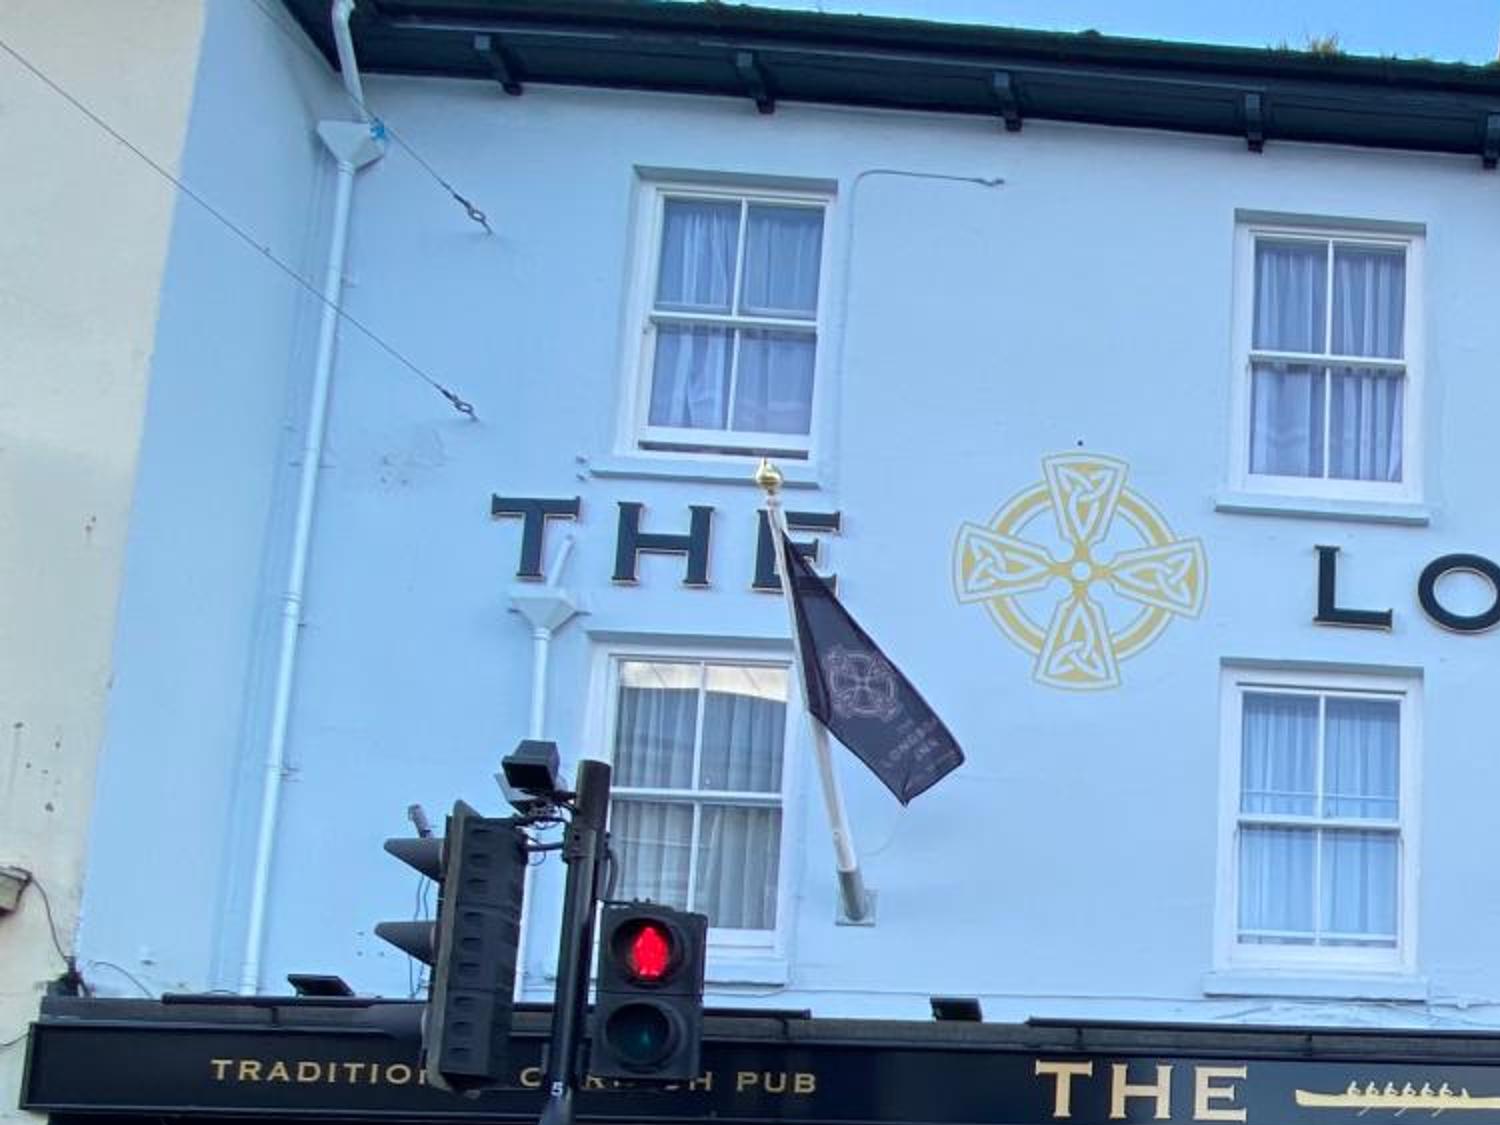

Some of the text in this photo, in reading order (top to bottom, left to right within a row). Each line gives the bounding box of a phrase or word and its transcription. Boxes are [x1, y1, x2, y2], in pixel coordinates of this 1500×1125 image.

[491, 494, 841, 593] THE
[211, 1059, 427, 1085] TRADITIO
[736, 1071, 816, 1093] PUB
[551, 1081, 563, 1097] 5
[1035, 1060, 1247, 1124] THE
